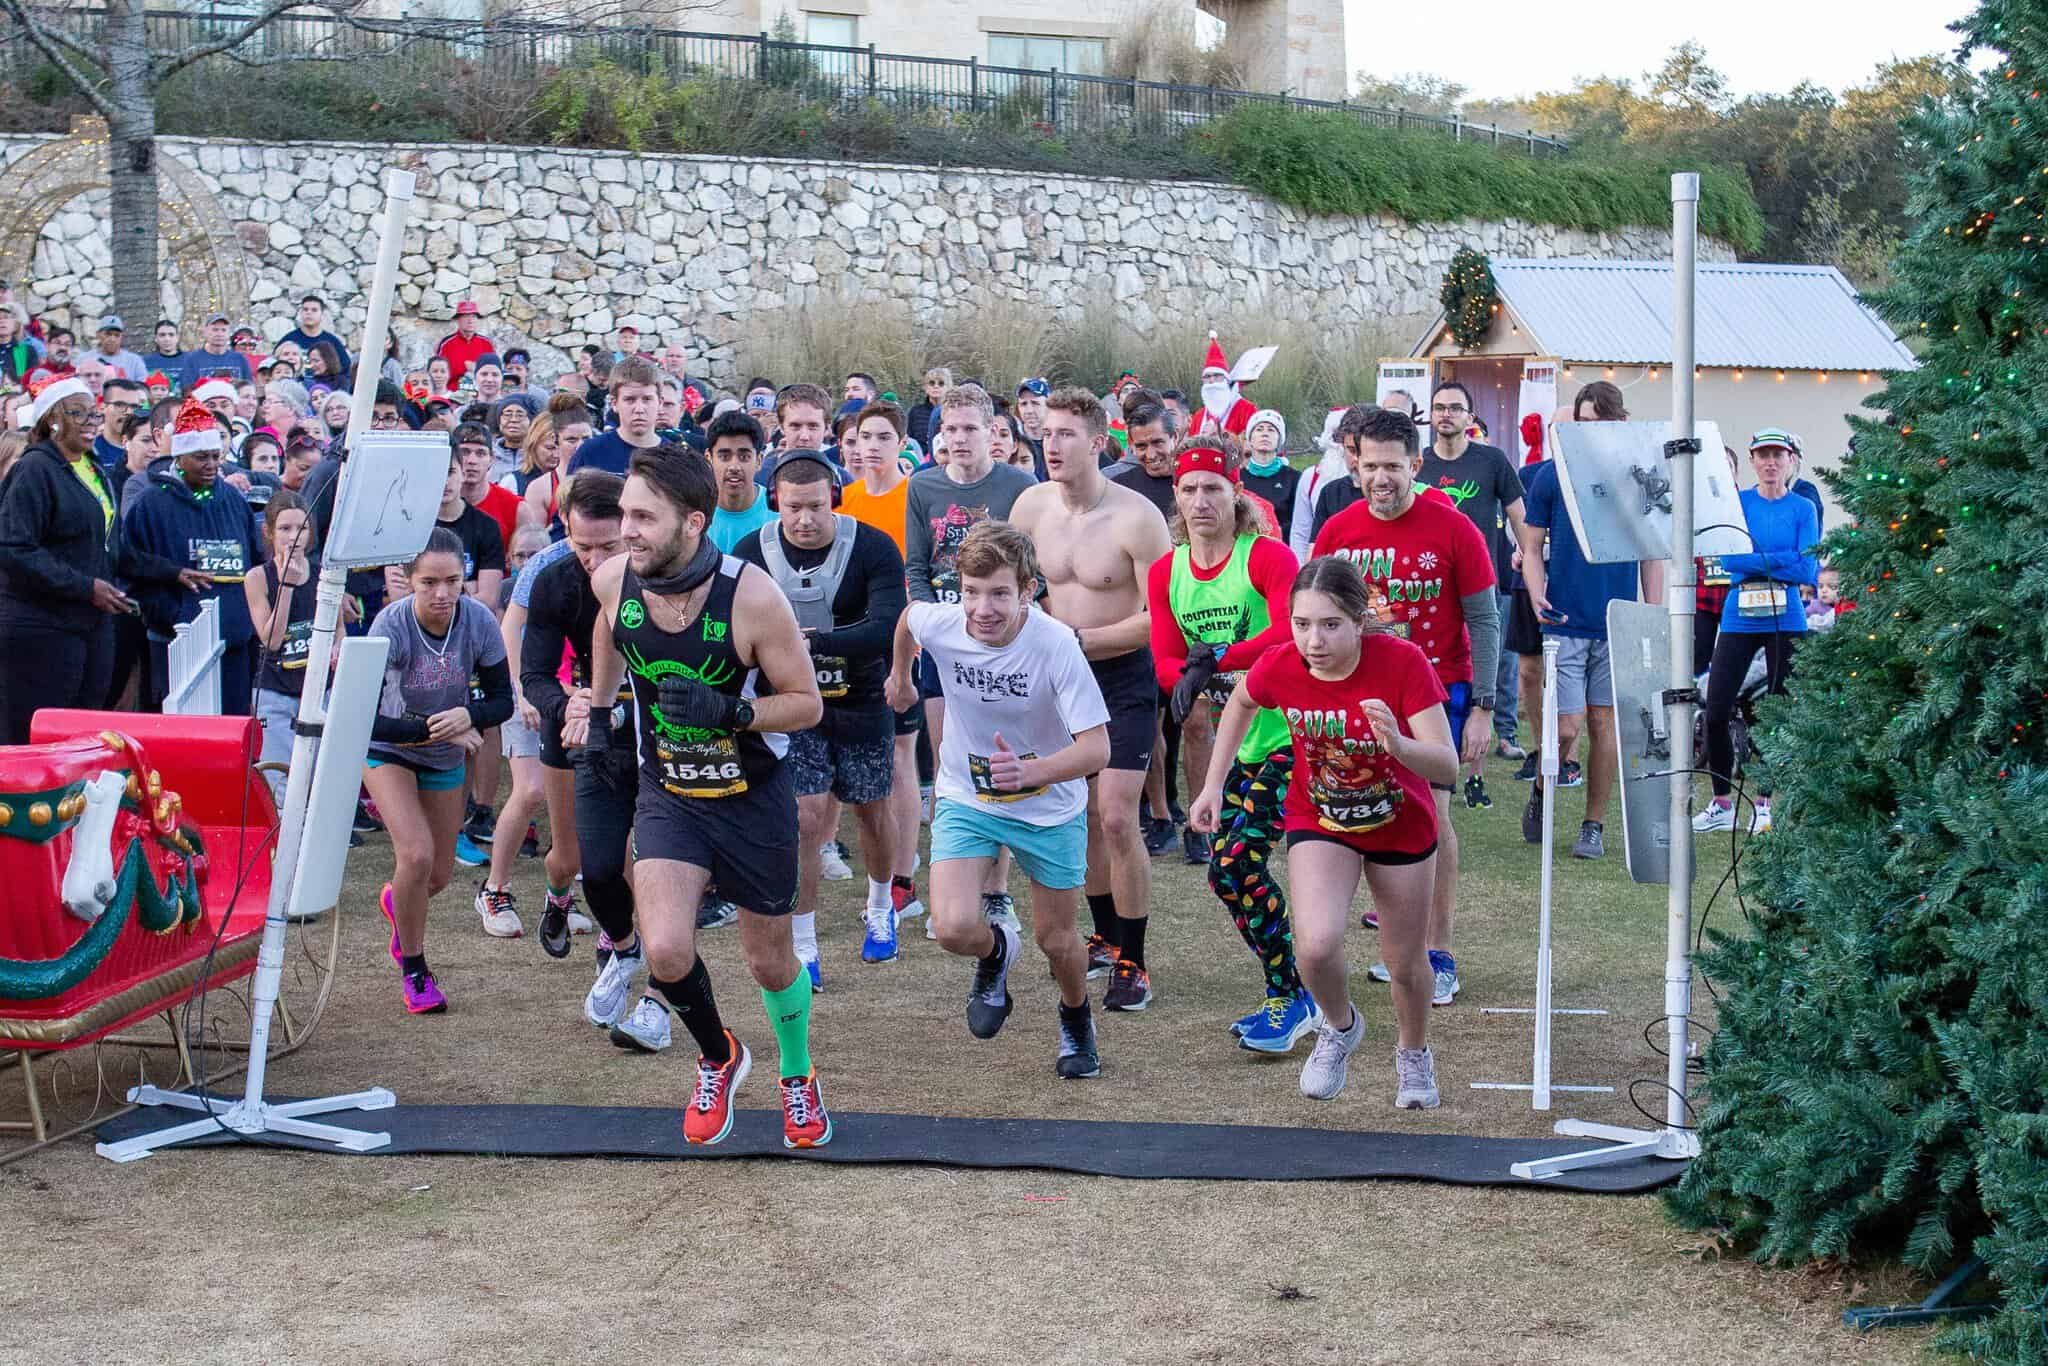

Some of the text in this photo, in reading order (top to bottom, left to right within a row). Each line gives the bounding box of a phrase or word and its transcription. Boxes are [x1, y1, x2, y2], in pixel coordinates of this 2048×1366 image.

[200, 556, 243, 570] 1740
[936, 589, 962, 604] 19
[1387, 577, 1442, 602] RUN
[953, 661, 1029, 697] NIKE
[1287, 707, 1347, 738] RUN
[663, 762, 741, 780] 1546
[1319, 799, 1392, 821] 1734
